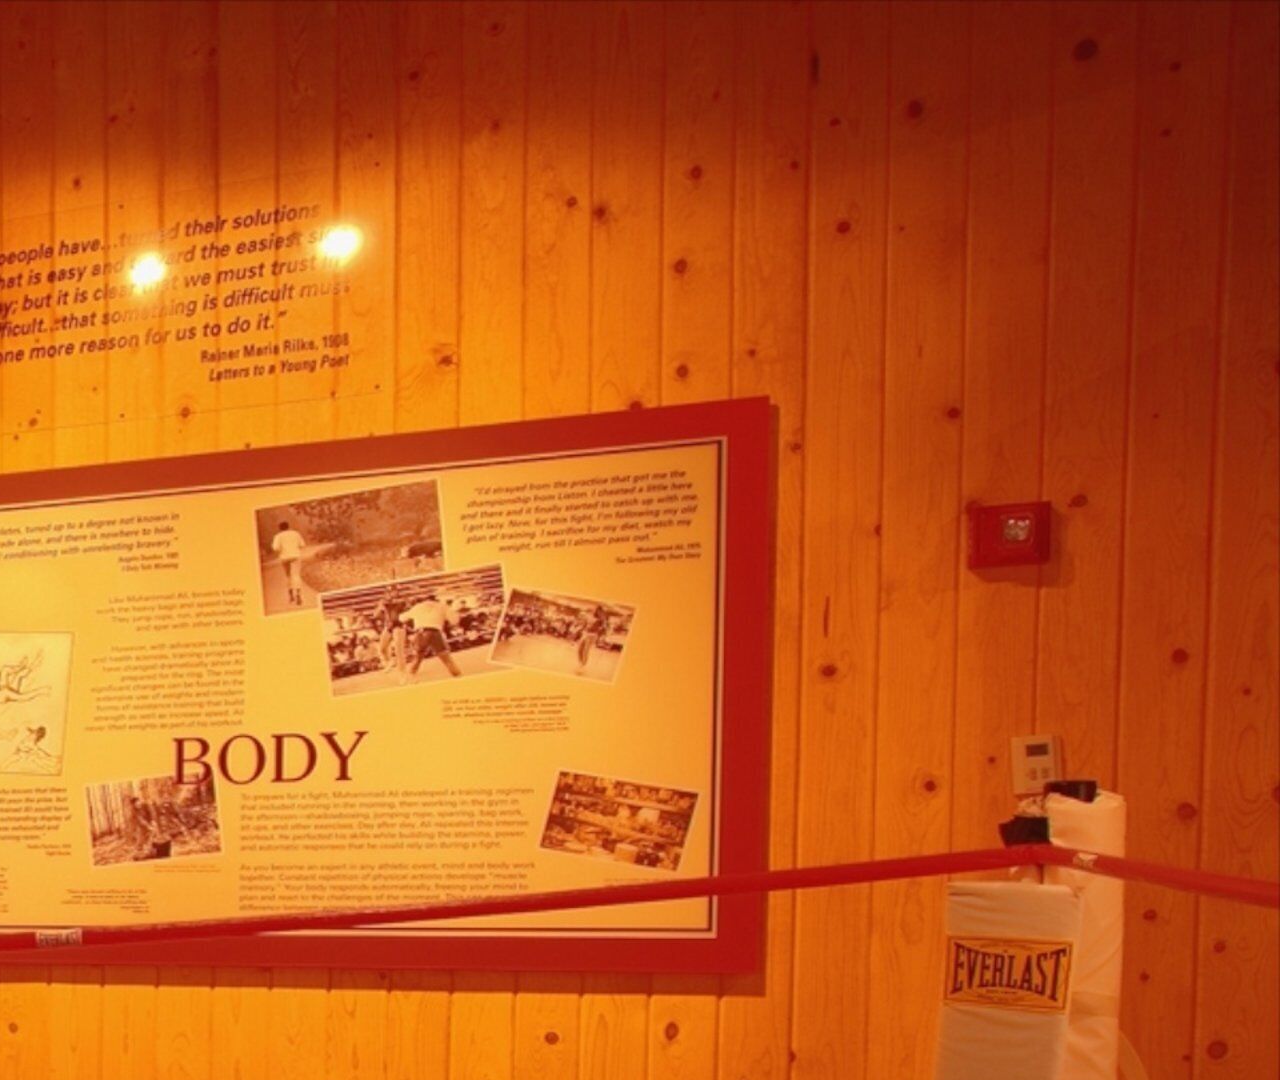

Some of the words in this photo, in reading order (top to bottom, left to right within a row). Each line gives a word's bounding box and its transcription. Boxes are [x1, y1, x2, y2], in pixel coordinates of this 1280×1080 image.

[185, 212, 229, 238] their
[231, 205, 318, 230] solutions
[21, 293, 53, 312] but
[56, 291, 69, 306] it
[73, 290, 88, 304] is
[183, 272, 211, 289] we
[215, 262, 265, 286] must
[271, 255, 317, 277] trust
[27, 268, 42, 286] is
[47, 265, 87, 284] easy
[200, 241, 231, 261] the
[235, 231, 302, 255] easiest
[202, 296, 218, 311] is
[223, 283, 295, 308] difficult
[28, 342, 75, 361] more
[79, 334, 140, 354] reason
[144, 328, 171, 345] for
[175, 326, 197, 342] us
[202, 322, 222, 338] to
[227, 316, 251, 335] do
[173, 731, 370, 786] BODY
[950, 941, 1067, 1002] EVERLAST
